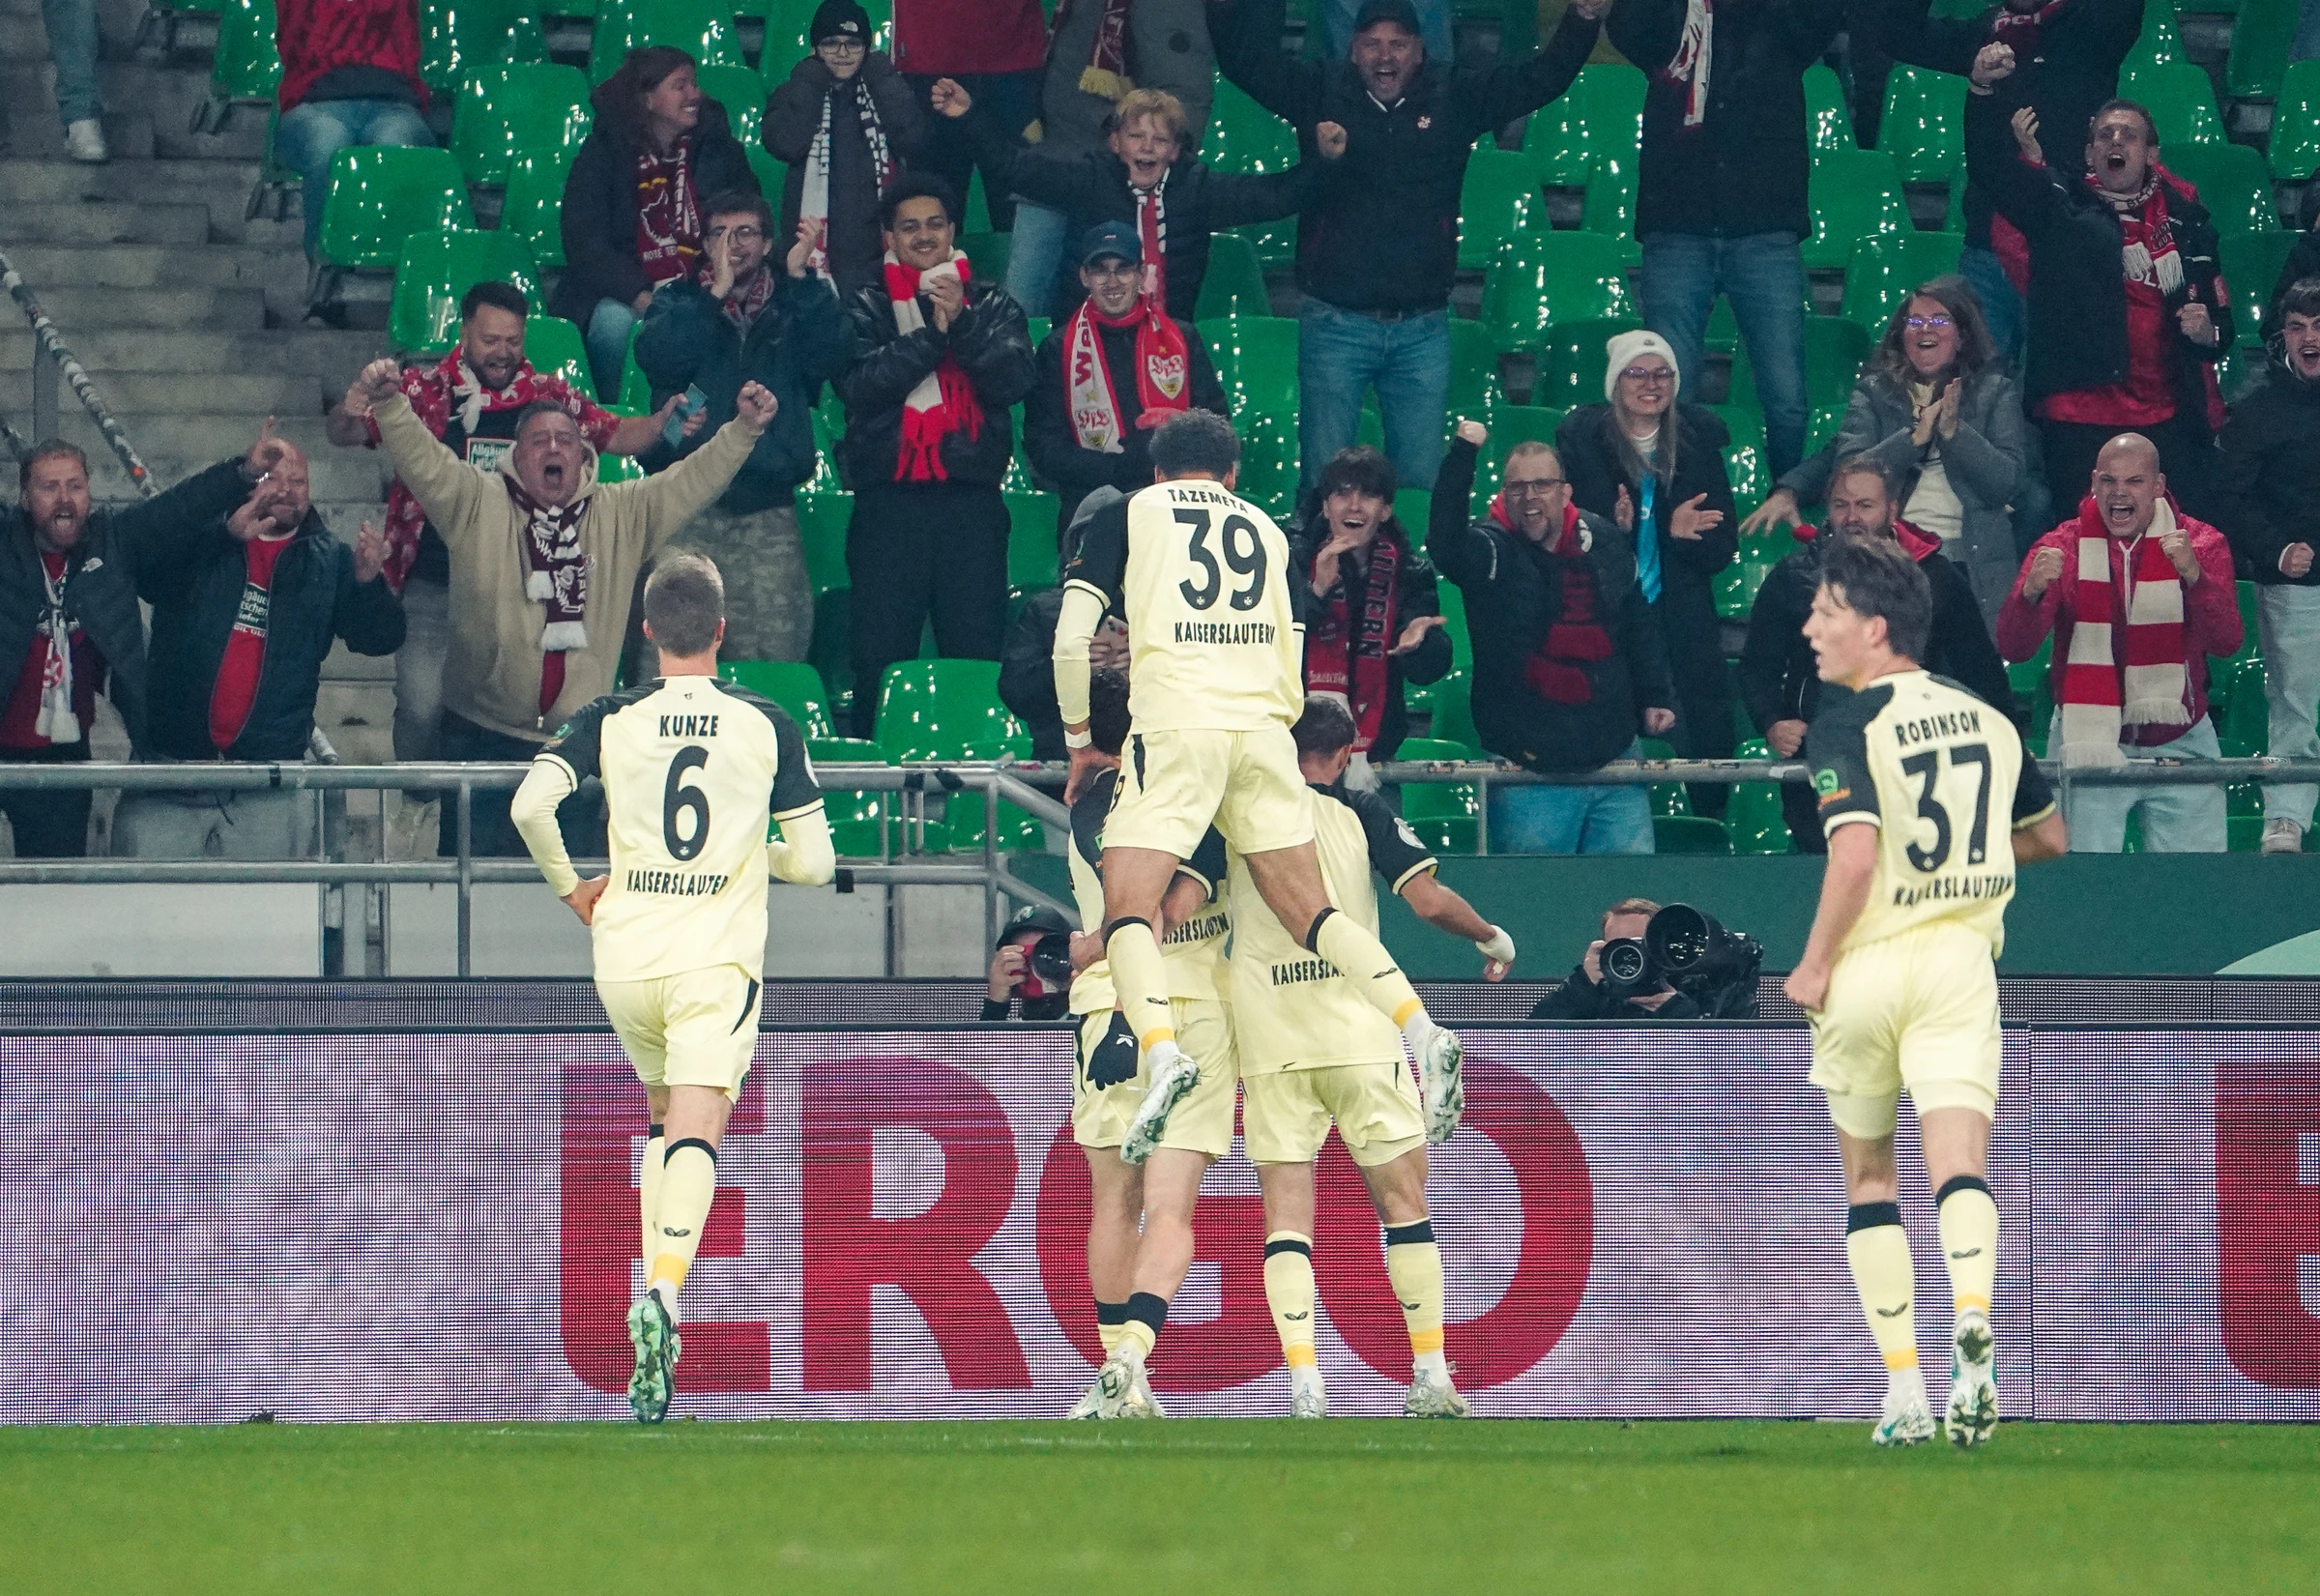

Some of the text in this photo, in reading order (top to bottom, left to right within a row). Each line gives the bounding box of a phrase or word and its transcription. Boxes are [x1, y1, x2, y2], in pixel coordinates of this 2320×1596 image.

[1168, 488, 1249, 513] TAZEMETA
[1172, 508, 1268, 612] 39
[659, 714, 719, 738] KUNZE
[1895, 710, 1982, 747] ROBINSON
[663, 744, 710, 862] 6
[1900, 742, 1992, 873] 37
[561, 1055, 1593, 1395] ERGO
